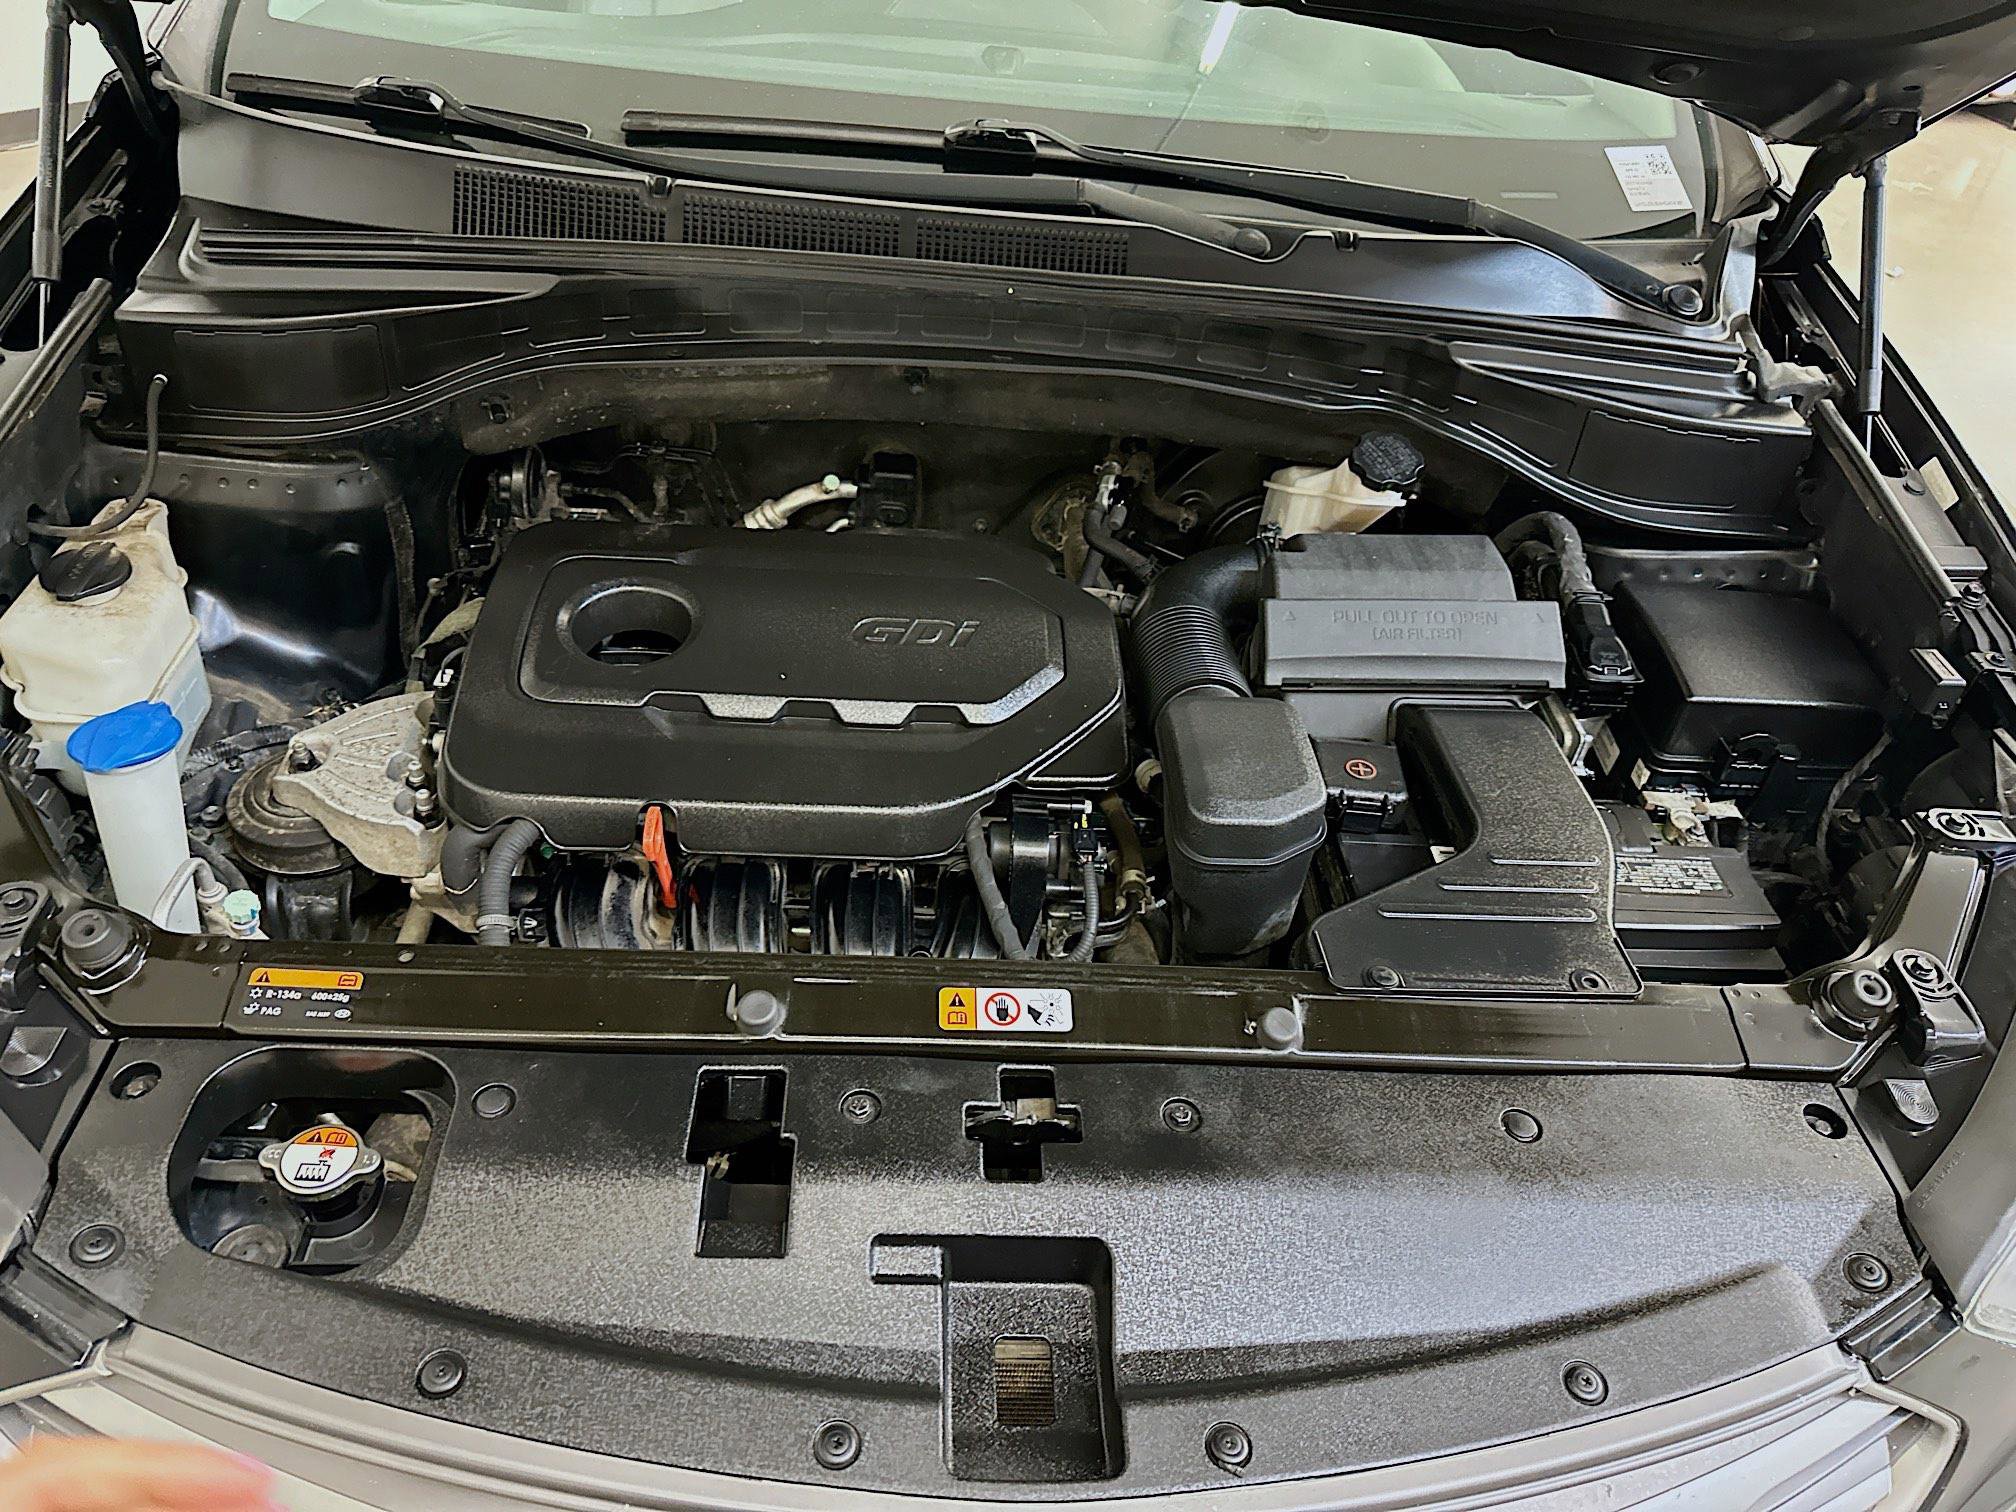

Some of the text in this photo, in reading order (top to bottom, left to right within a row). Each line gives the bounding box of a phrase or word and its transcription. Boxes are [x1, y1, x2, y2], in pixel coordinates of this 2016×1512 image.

[1333, 609, 1498, 625] PULL OUT TO OPEN
[265, 989, 302, 1000] R-134a
[260, 1006, 282, 1016] PAG
